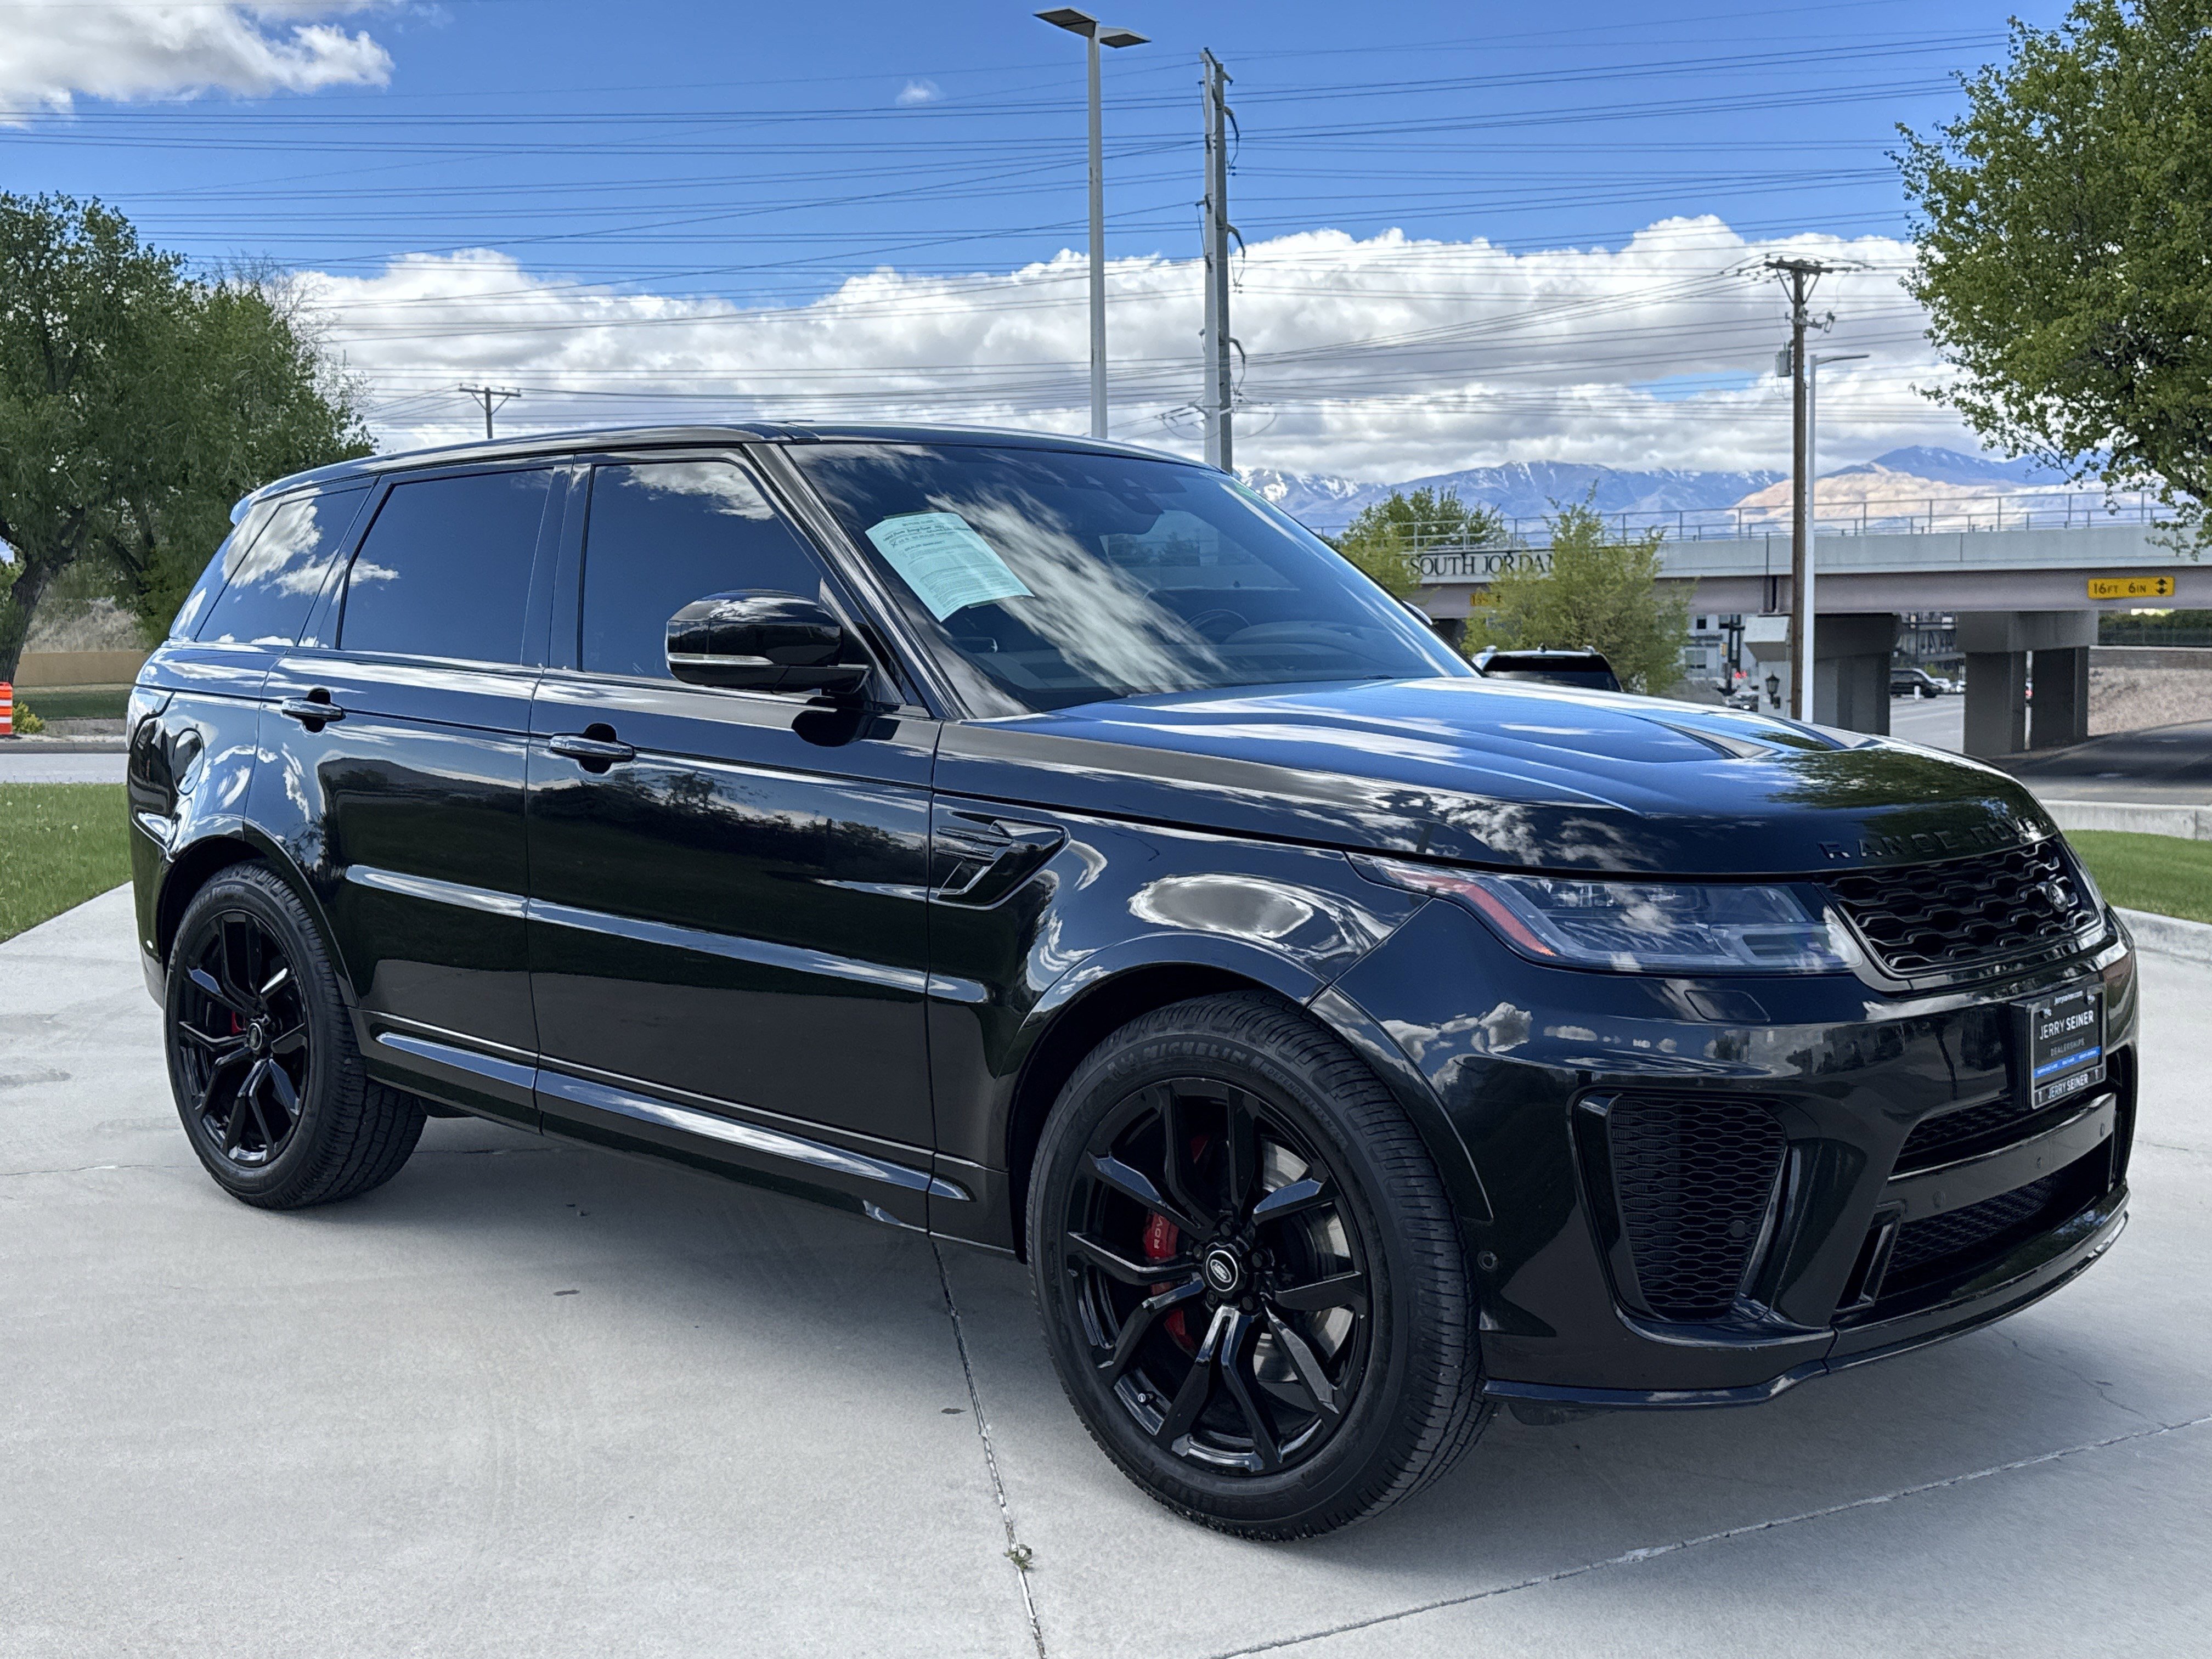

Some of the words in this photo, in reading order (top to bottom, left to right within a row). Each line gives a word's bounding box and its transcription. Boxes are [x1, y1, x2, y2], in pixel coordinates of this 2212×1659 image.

[1410, 555, 1475, 575] SOUTH
[1817, 830, 1960, 859] RANGE
[2039, 1018, 2065, 1040] JERRY
[2066, 1010, 2094, 1031] SEINER
[1143, 1042, 1247, 1063] MICHELIN
[1267, 1068, 1311, 1103] DEFENDER
[2067, 1073, 2089, 1091] SEINER
